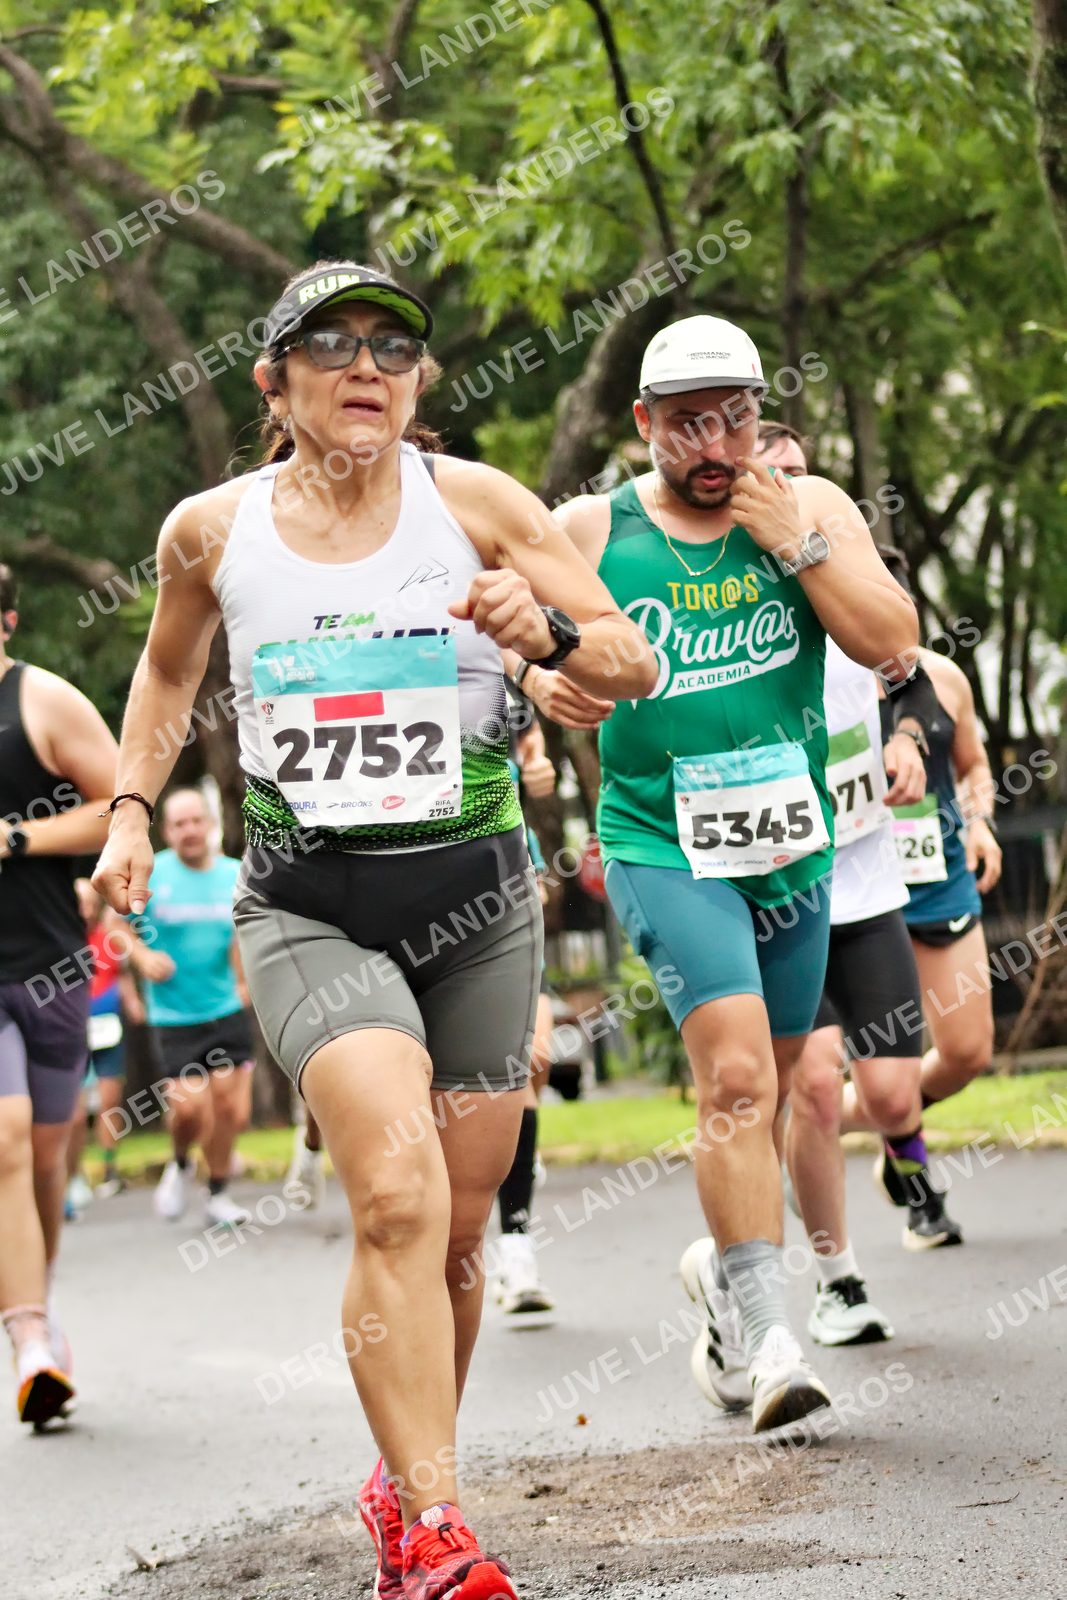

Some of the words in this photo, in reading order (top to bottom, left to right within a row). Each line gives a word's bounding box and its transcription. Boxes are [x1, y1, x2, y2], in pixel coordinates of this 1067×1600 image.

[299, 274, 360, 305] RUN
[666, 573, 759, 611] TOR@S
[313, 611, 376, 630] TEAM
[677, 665, 750, 690] ACADEMIA
[272, 721, 447, 783] 2752
[341, 800, 373, 809] BROOKS
[428, 806, 455, 818] 2752
[435, 799, 451, 807] RIFA
[692, 800, 814, 850] 5345
[895, 834, 936, 859] 26
